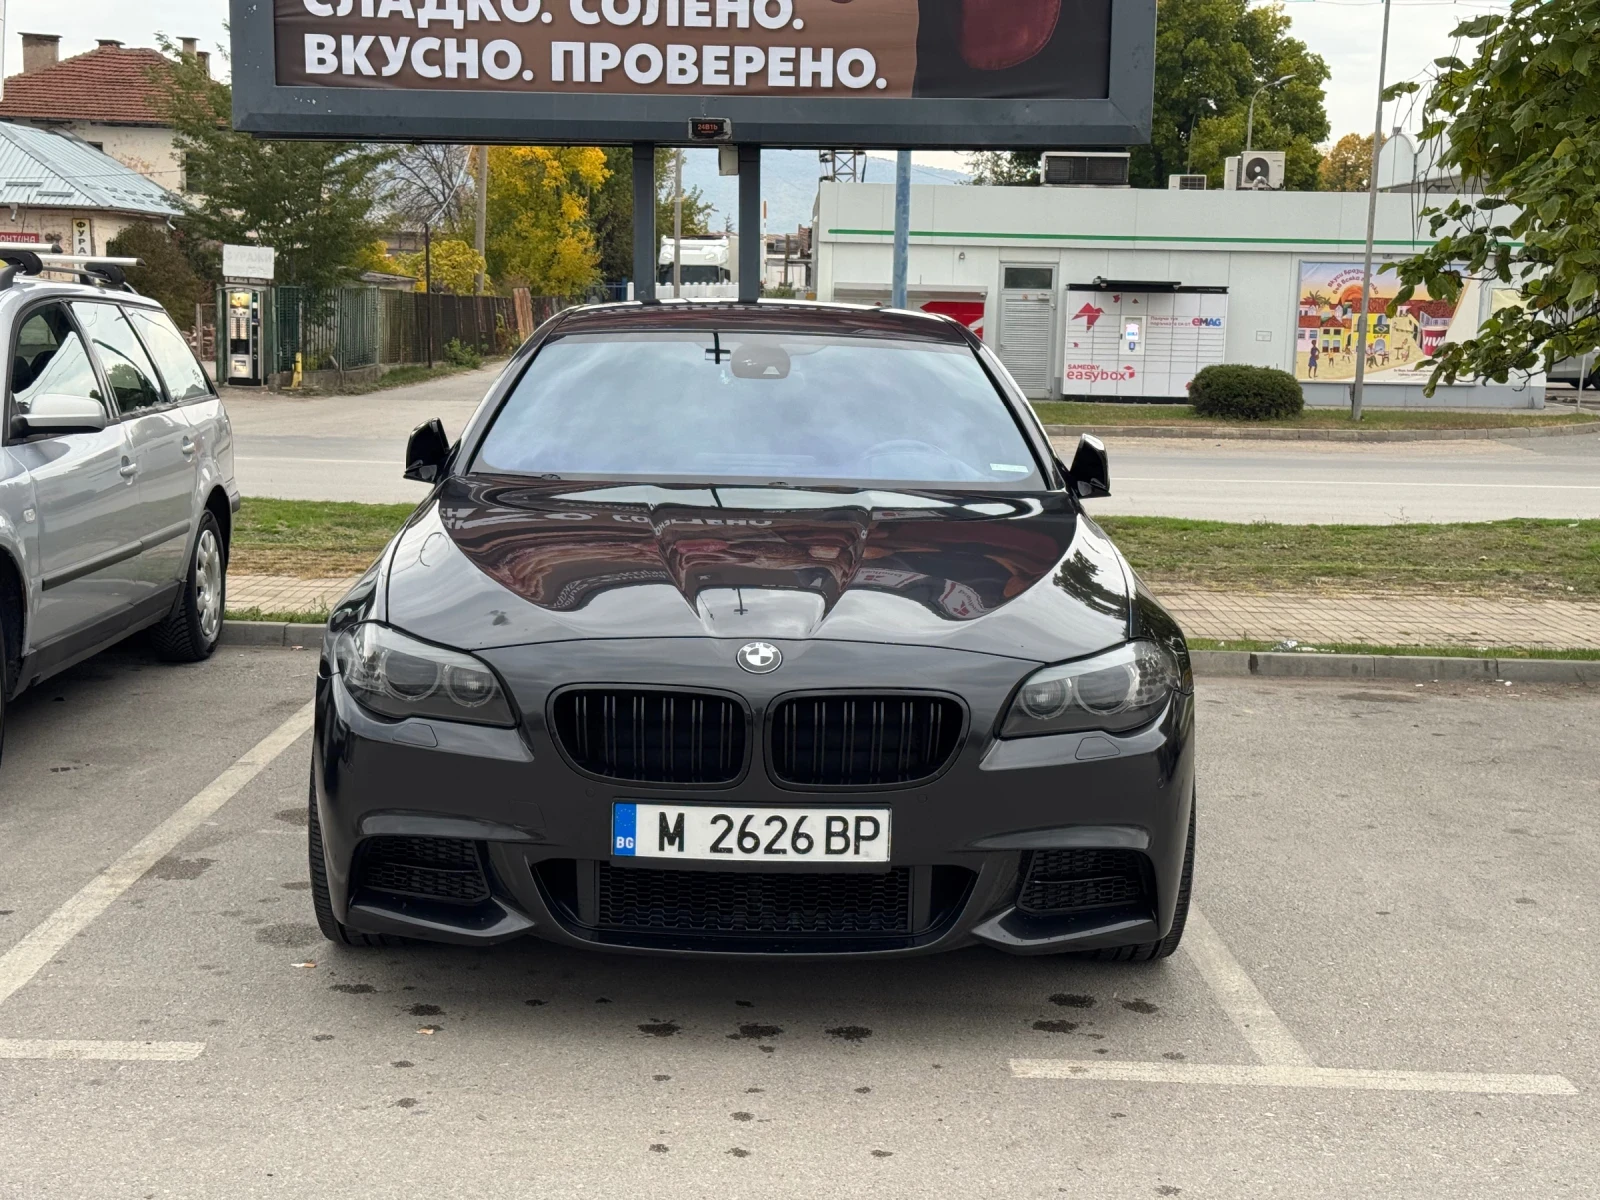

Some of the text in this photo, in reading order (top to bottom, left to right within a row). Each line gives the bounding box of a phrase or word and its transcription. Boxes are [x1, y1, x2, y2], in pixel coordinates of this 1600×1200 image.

[569, 0, 804, 30] СОЛЕНО.
[304, 33, 888, 90] ВКУСНО. ПРОВЕРЕНО.
[76, 221, 87, 254] ФУРА
[1191, 317, 1222, 327] eMAG
[1066, 369, 1126, 383] easybox
[616, 836, 634, 849] BG
[659, 811, 881, 855] M 2626 BP
